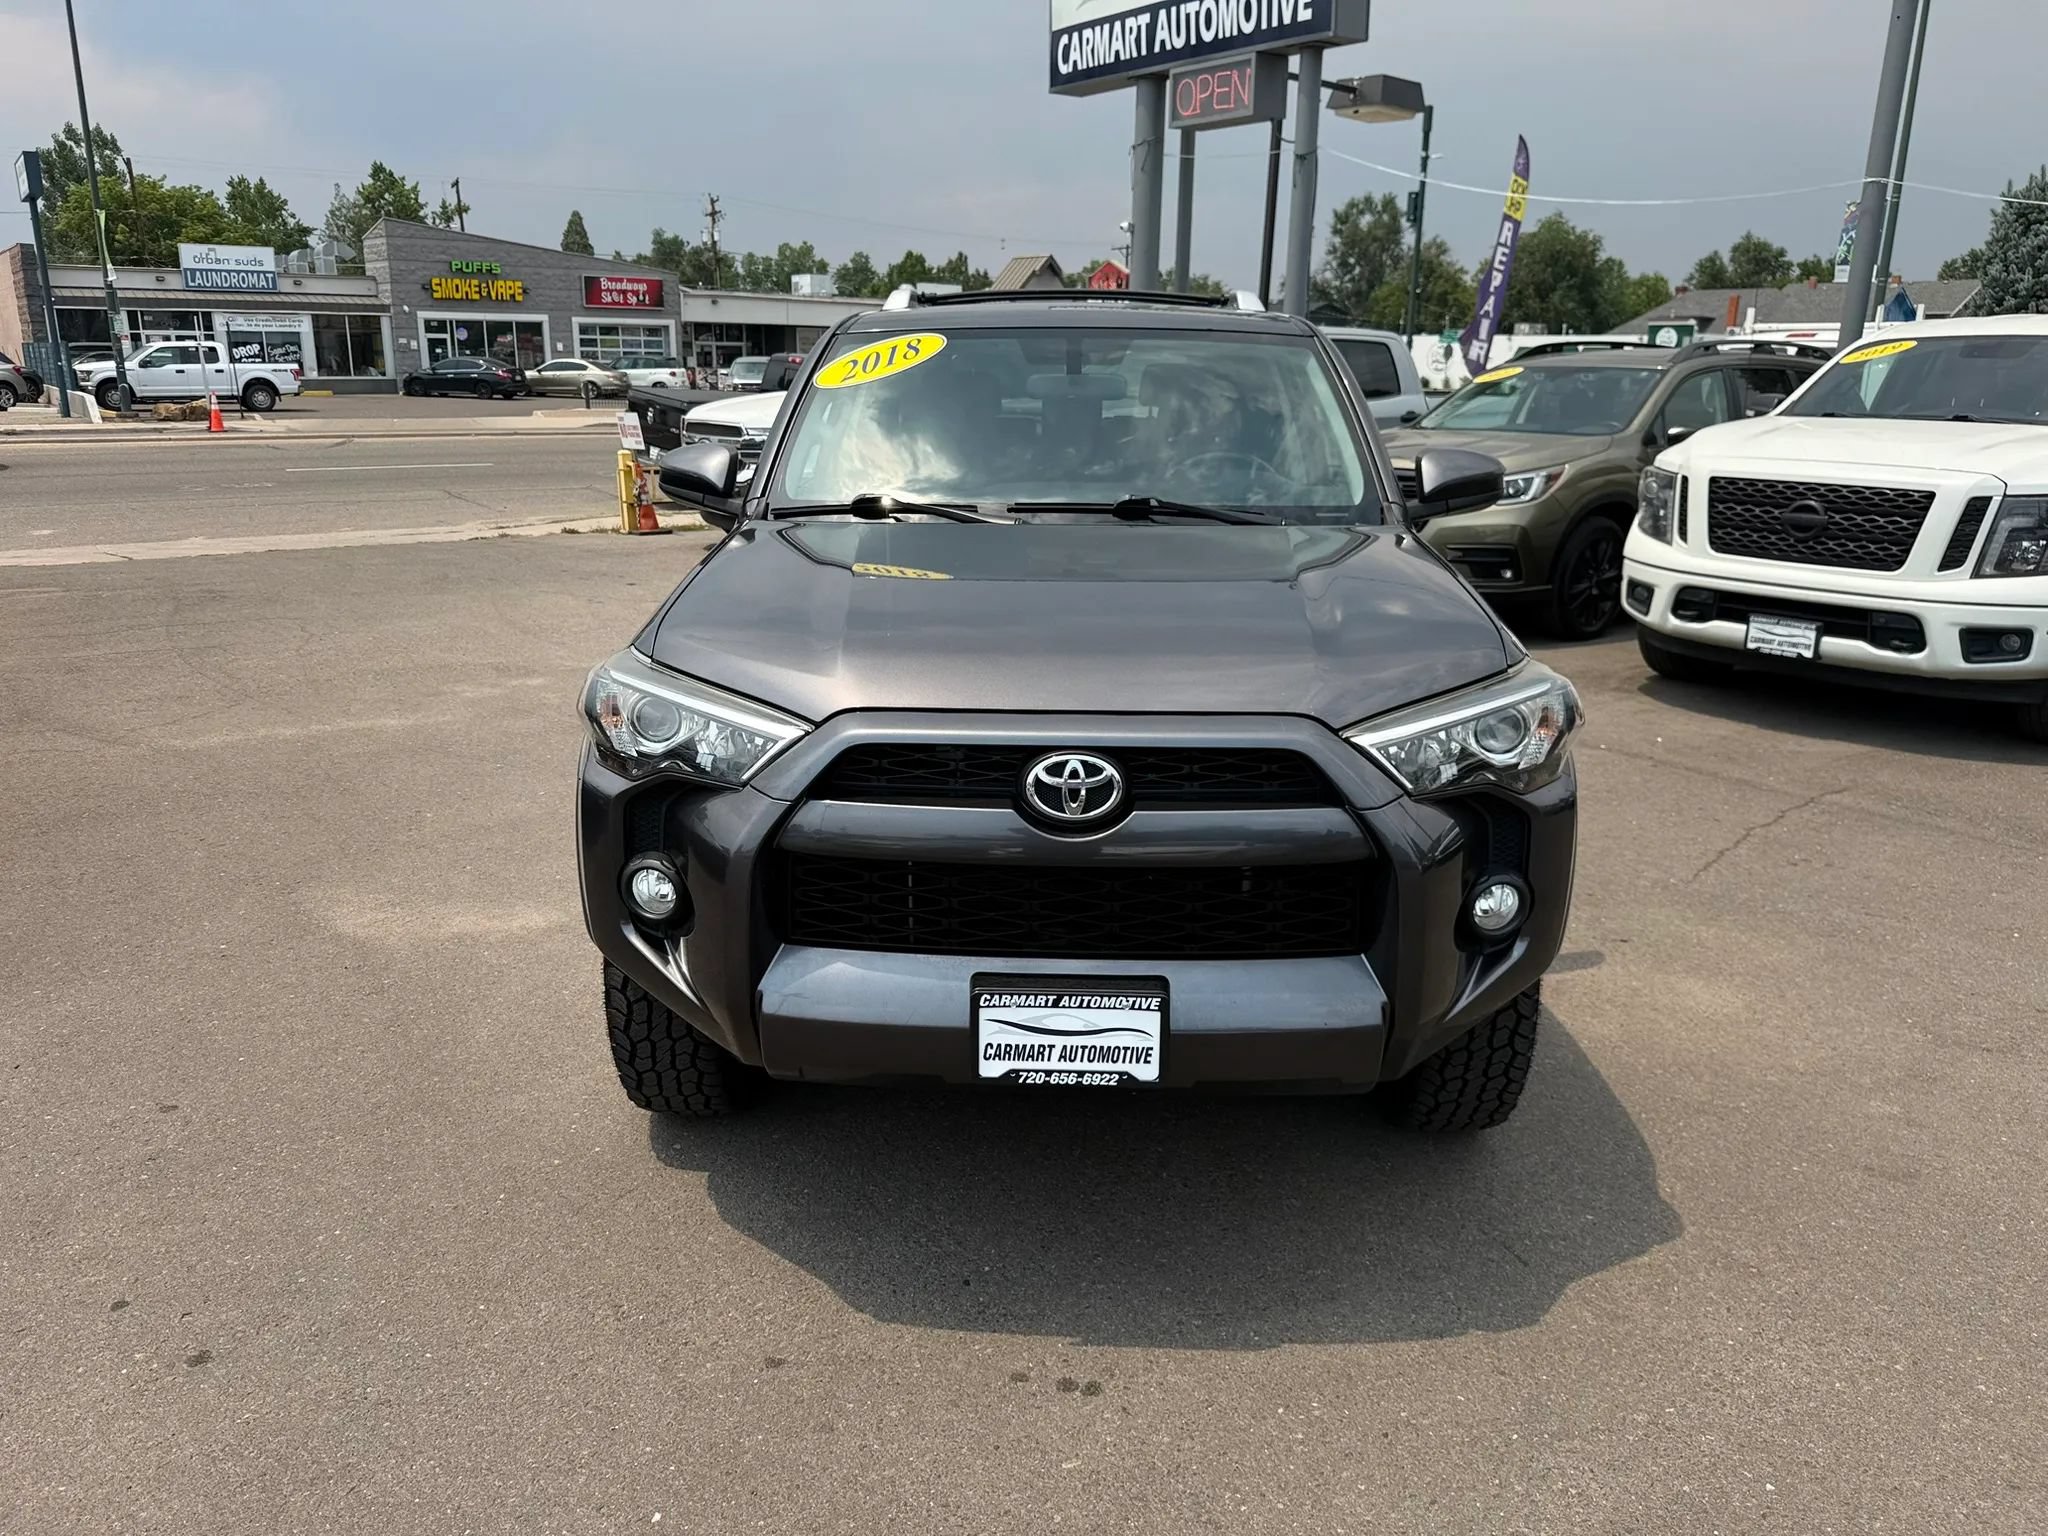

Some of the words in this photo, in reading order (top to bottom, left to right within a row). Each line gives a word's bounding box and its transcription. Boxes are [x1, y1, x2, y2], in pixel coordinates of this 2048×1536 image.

[1057, 12, 1150, 75] CARMART
[1153, 0, 1314, 53] AUTOMOTIVE
[1176, 68, 1252, 117] OPEN
[234, 257, 264, 267] suds
[450, 260, 502, 274] PUFFS
[186, 270, 274, 289] LAUNDROMAT
[431, 277, 480, 300] SMOKE
[481, 283, 488, 297] &
[488, 279, 524, 302] VAPE
[1467, 220, 1515, 364] REPAIR
[232, 343, 261, 360] DROP
[841, 337, 922, 384] 2018
[979, 994, 1056, 1007] CARMART
[1059, 996, 1161, 1010] AUTOMOTIVE
[983, 1043, 1055, 1062] CARMART
[1058, 1044, 1153, 1064] AUTOMOTIVE
[1018, 1072, 1119, 1086] 720-656-6922
